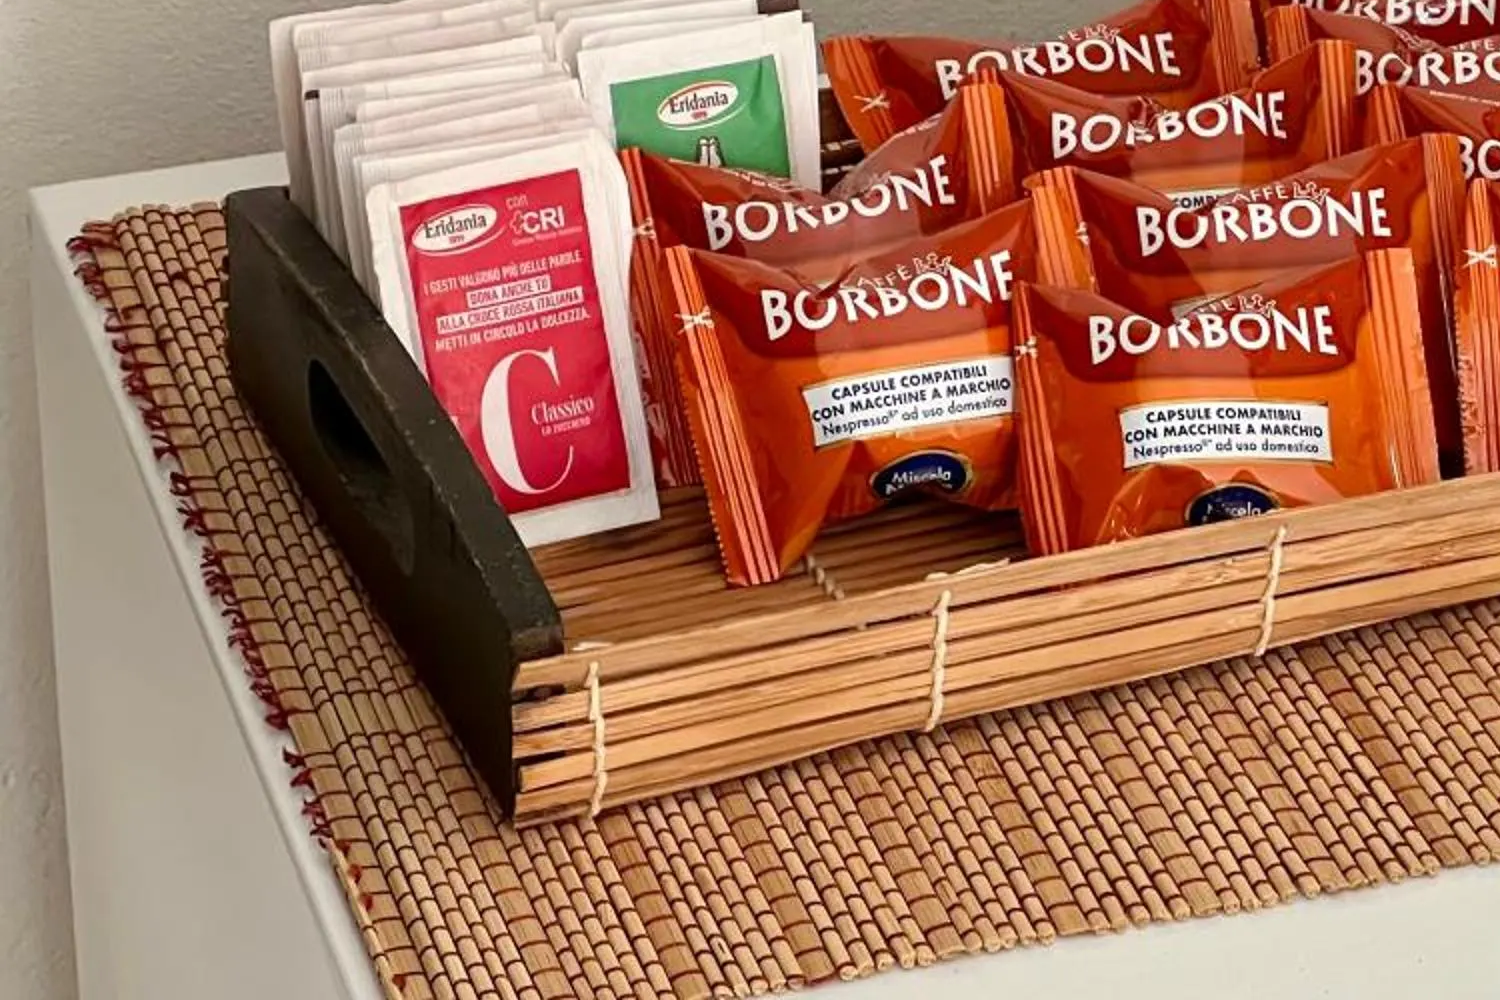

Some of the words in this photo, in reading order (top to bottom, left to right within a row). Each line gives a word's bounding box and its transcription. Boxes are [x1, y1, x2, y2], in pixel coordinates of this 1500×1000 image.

[936, 32, 1181, 100] BORBONE
[670, 91, 729, 113] Eridania
[1051, 91, 1288, 160] BORBONE
[424, 213, 488, 239] Eridania
[523, 205, 566, 235] CRI
[1137, 187, 1393, 257] BORBONE
[760, 250, 1014, 341] BORBONE
[435, 333, 468, 352] METTI
[525, 316, 540, 333] LA
[440, 315, 465, 332] ALLA
[467, 308, 500, 326] CROCE
[503, 302, 535, 320] ROSSA
[1089, 305, 1339, 365] BORBONE
[812, 402, 846, 423] CON
[850, 390, 927, 413] MACCHINE
[931, 388, 943, 401] A
[946, 377, 1012, 399] MARCHIO
[831, 378, 897, 401] CAPSULE
[899, 365, 988, 389] COMPATIBILI
[481, 345, 575, 495] C
[531, 394, 594, 426] Classico
[901, 406, 920, 422] ad
[922, 406, 945, 420] uso
[948, 396, 1008, 416] domestico
[1145, 407, 1212, 423] CAPSULE
[1215, 406, 1302, 422] COMPATIBILI
[1125, 427, 1159, 444] CON
[1163, 422, 1242, 438] MACCHINE
[1246, 422, 1256, 435] A
[1261, 423, 1324, 439] MARCHIO
[1215, 437, 1234, 452] ad
[1236, 441, 1258, 453] uso
[1261, 438, 1320, 454] domestico
